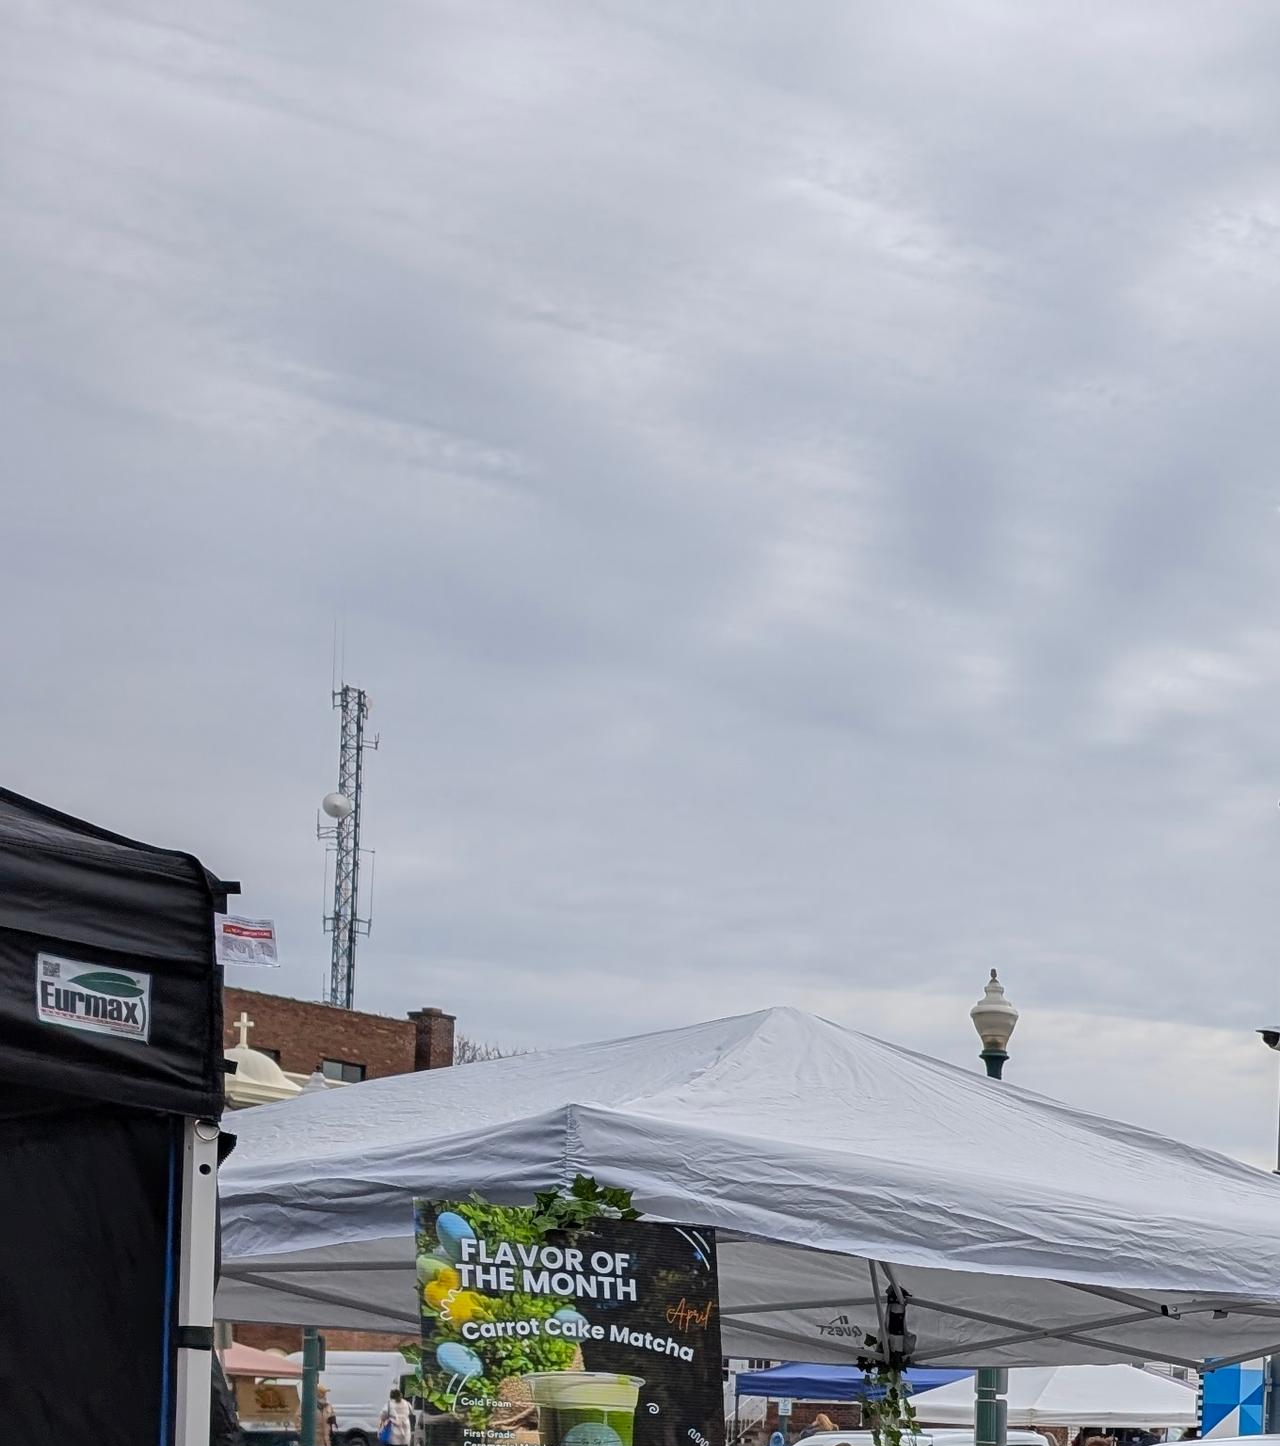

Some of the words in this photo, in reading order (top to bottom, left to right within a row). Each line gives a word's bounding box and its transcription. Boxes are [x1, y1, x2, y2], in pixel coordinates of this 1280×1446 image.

[40, 980, 140, 1026] Eurmax
[460, 1237, 584, 1273] FLAVOR
[590, 1250, 631, 1276] OF
[454, 1262, 516, 1292] THE
[521, 1267, 638, 1302] MONTH
[665, 1297, 714, 1333] April
[461, 1316, 540, 1340] Carrot
[544, 1317, 605, 1341] Cake
[609, 1323, 696, 1363] Matcha
[460, 1397, 484, 1407] Cold
[486, 1398, 512, 1409] Foam
[463, 1428, 485, 1438] First
[486, 1429, 517, 1439] Grade
